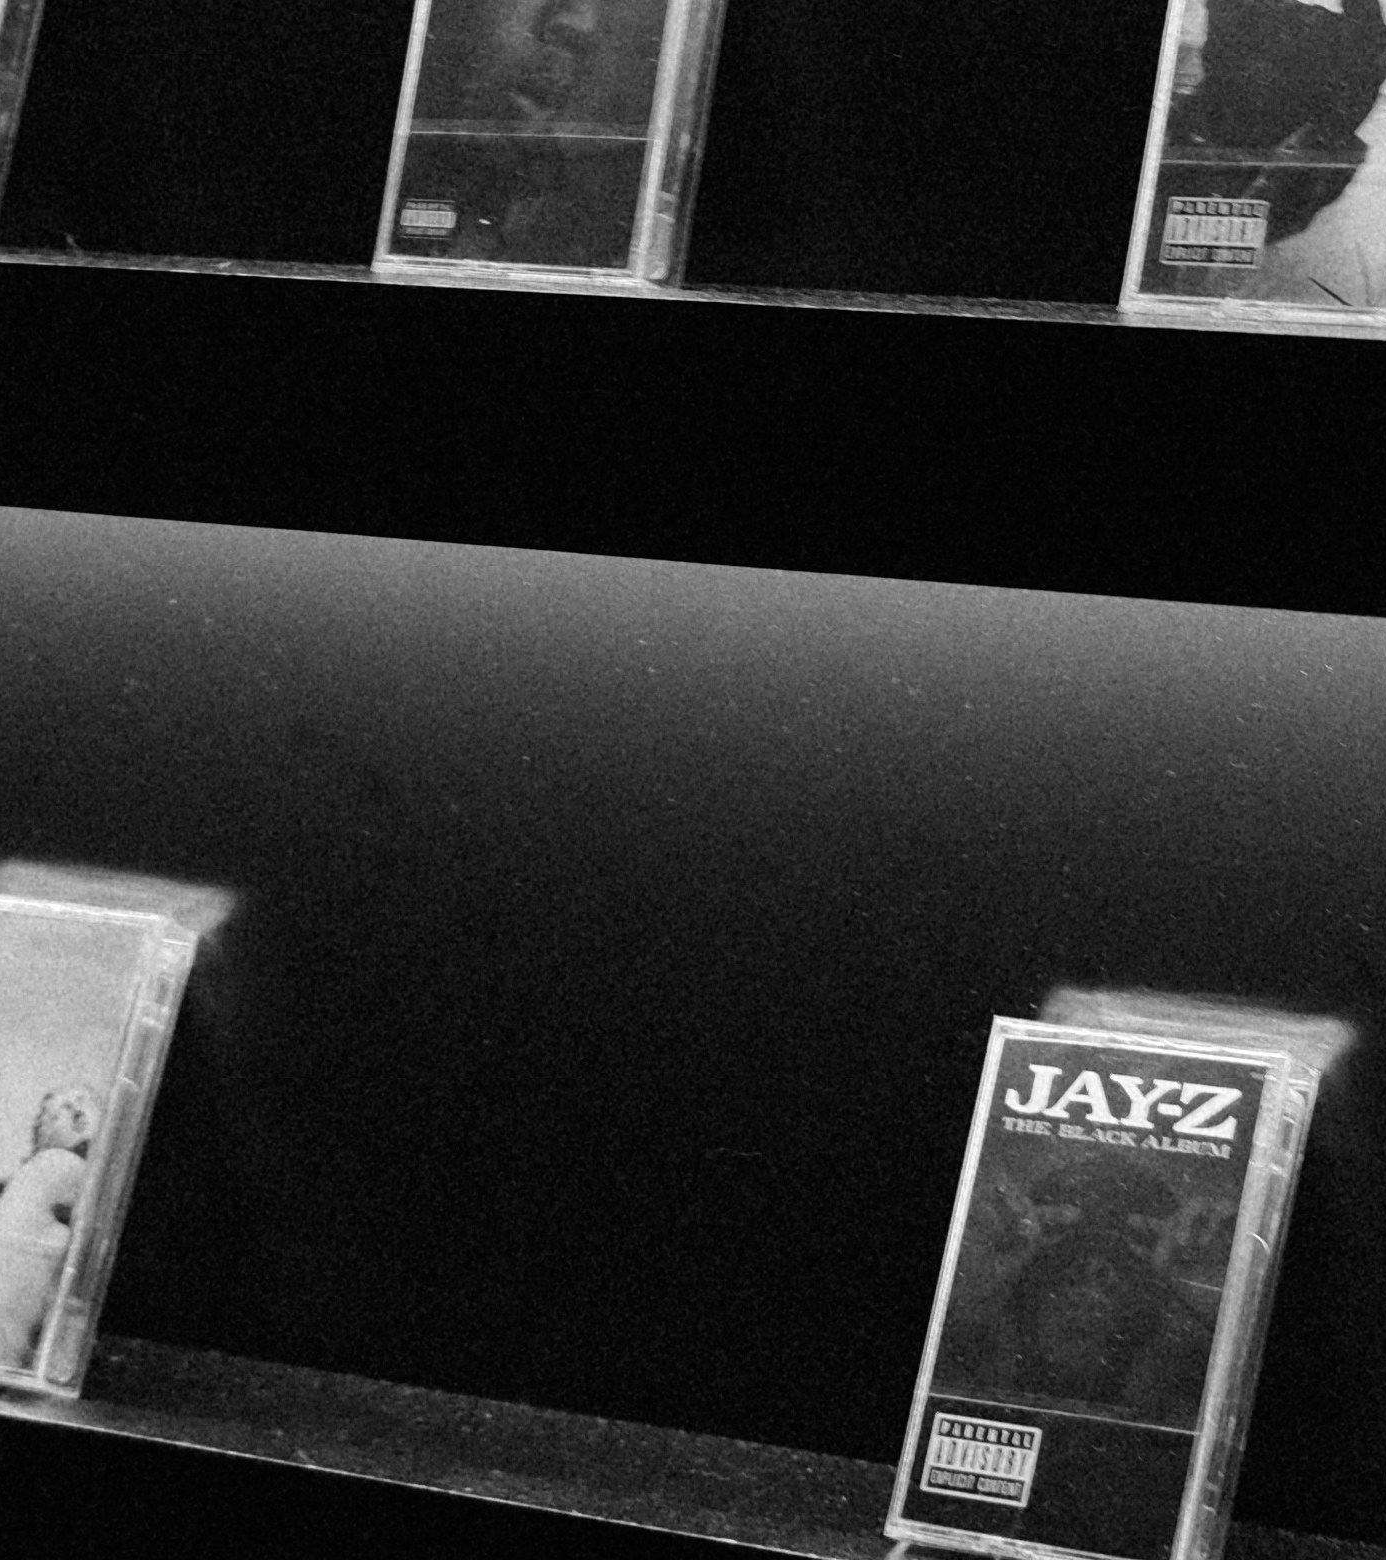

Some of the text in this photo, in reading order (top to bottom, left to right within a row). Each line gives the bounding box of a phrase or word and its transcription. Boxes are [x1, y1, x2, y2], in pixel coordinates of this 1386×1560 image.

[1004, 1064, 1243, 1141] JAY-Z
[1001, 1116, 1233, 1160] THE BLACK ALBUM
